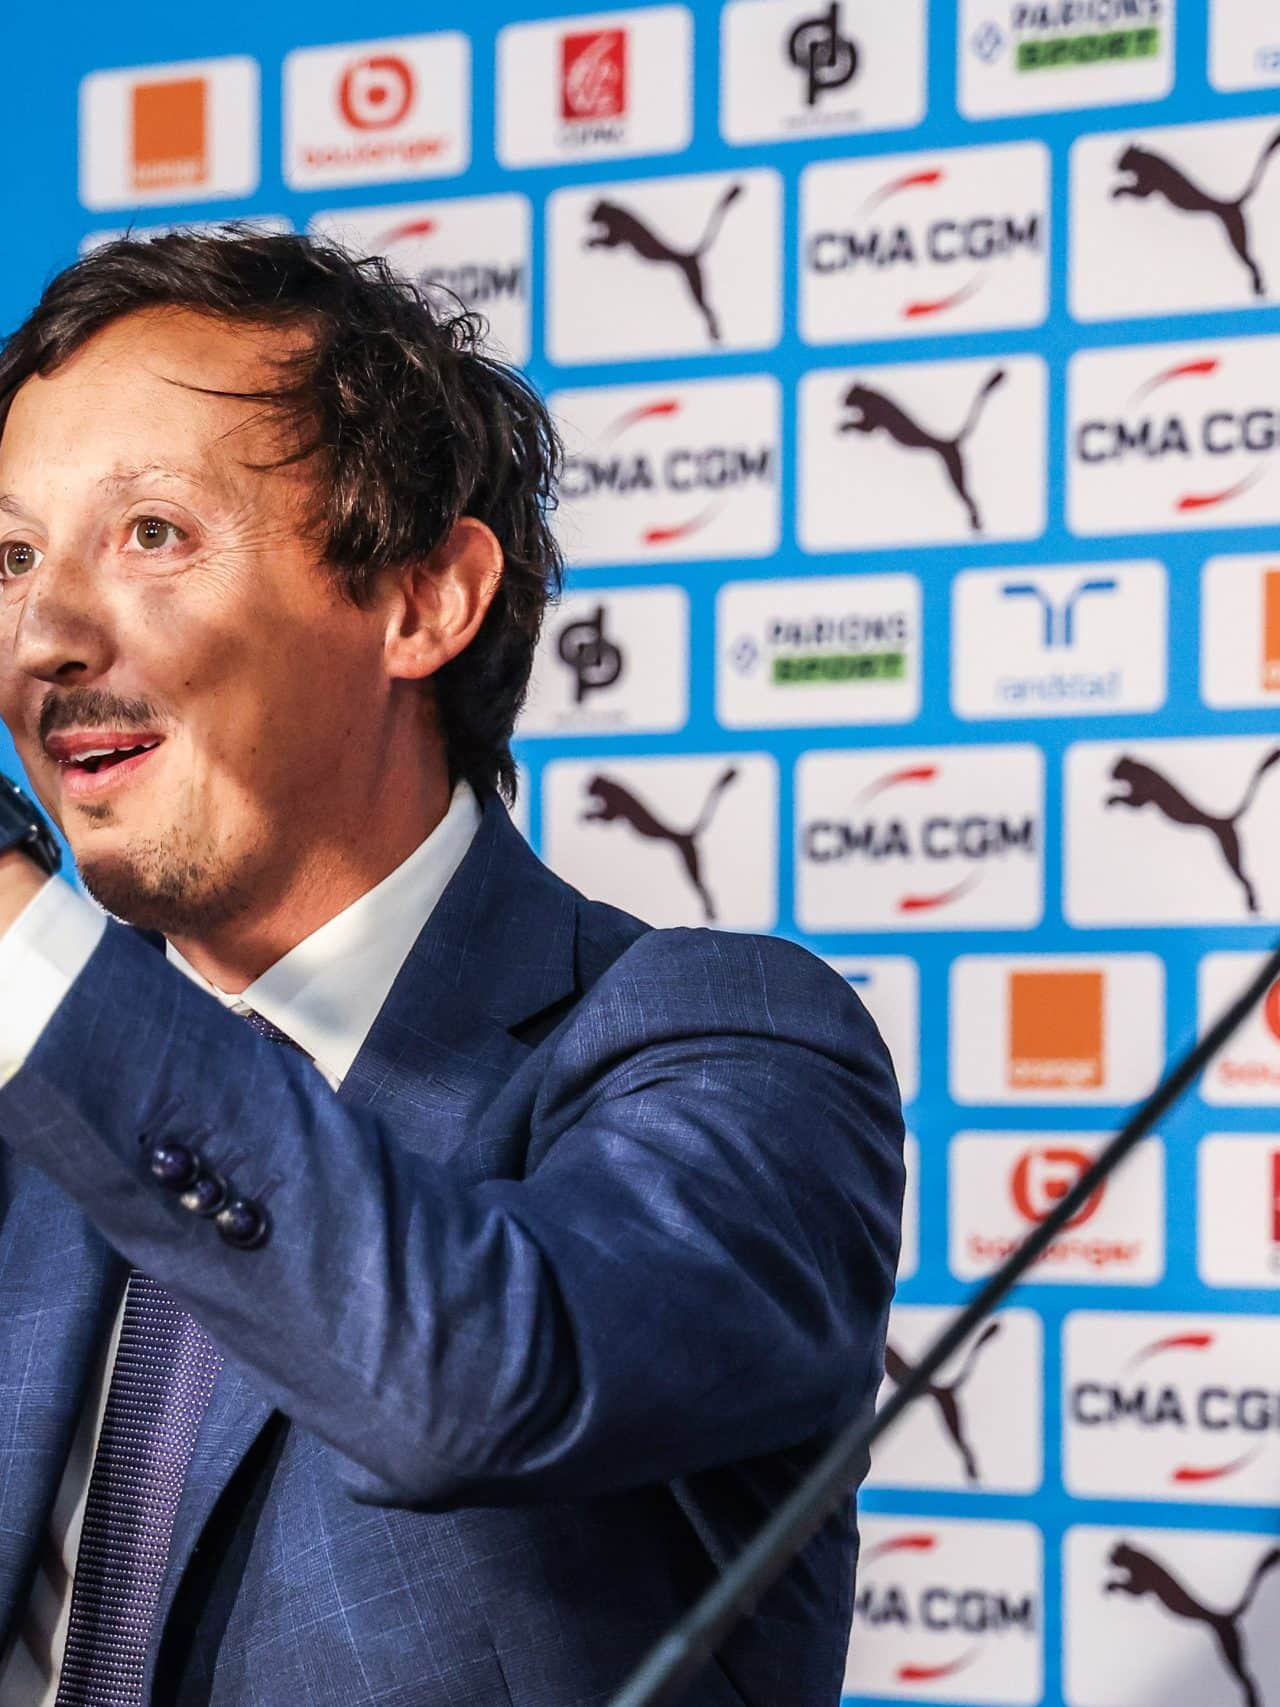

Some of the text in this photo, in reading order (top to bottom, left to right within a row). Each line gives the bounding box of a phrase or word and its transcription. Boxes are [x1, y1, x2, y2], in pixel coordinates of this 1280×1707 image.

[810, 214, 1040, 275] CMA CGM
[1077, 409, 1280, 464] CMA CG
[558, 446, 773, 500] CMA CGM
[769, 613, 906, 646] PARIONS
[808, 815, 1035, 865] CMA CGM
[1072, 1383, 1280, 1432] CMA CG
[854, 1583, 1036, 1634] MA CGM
